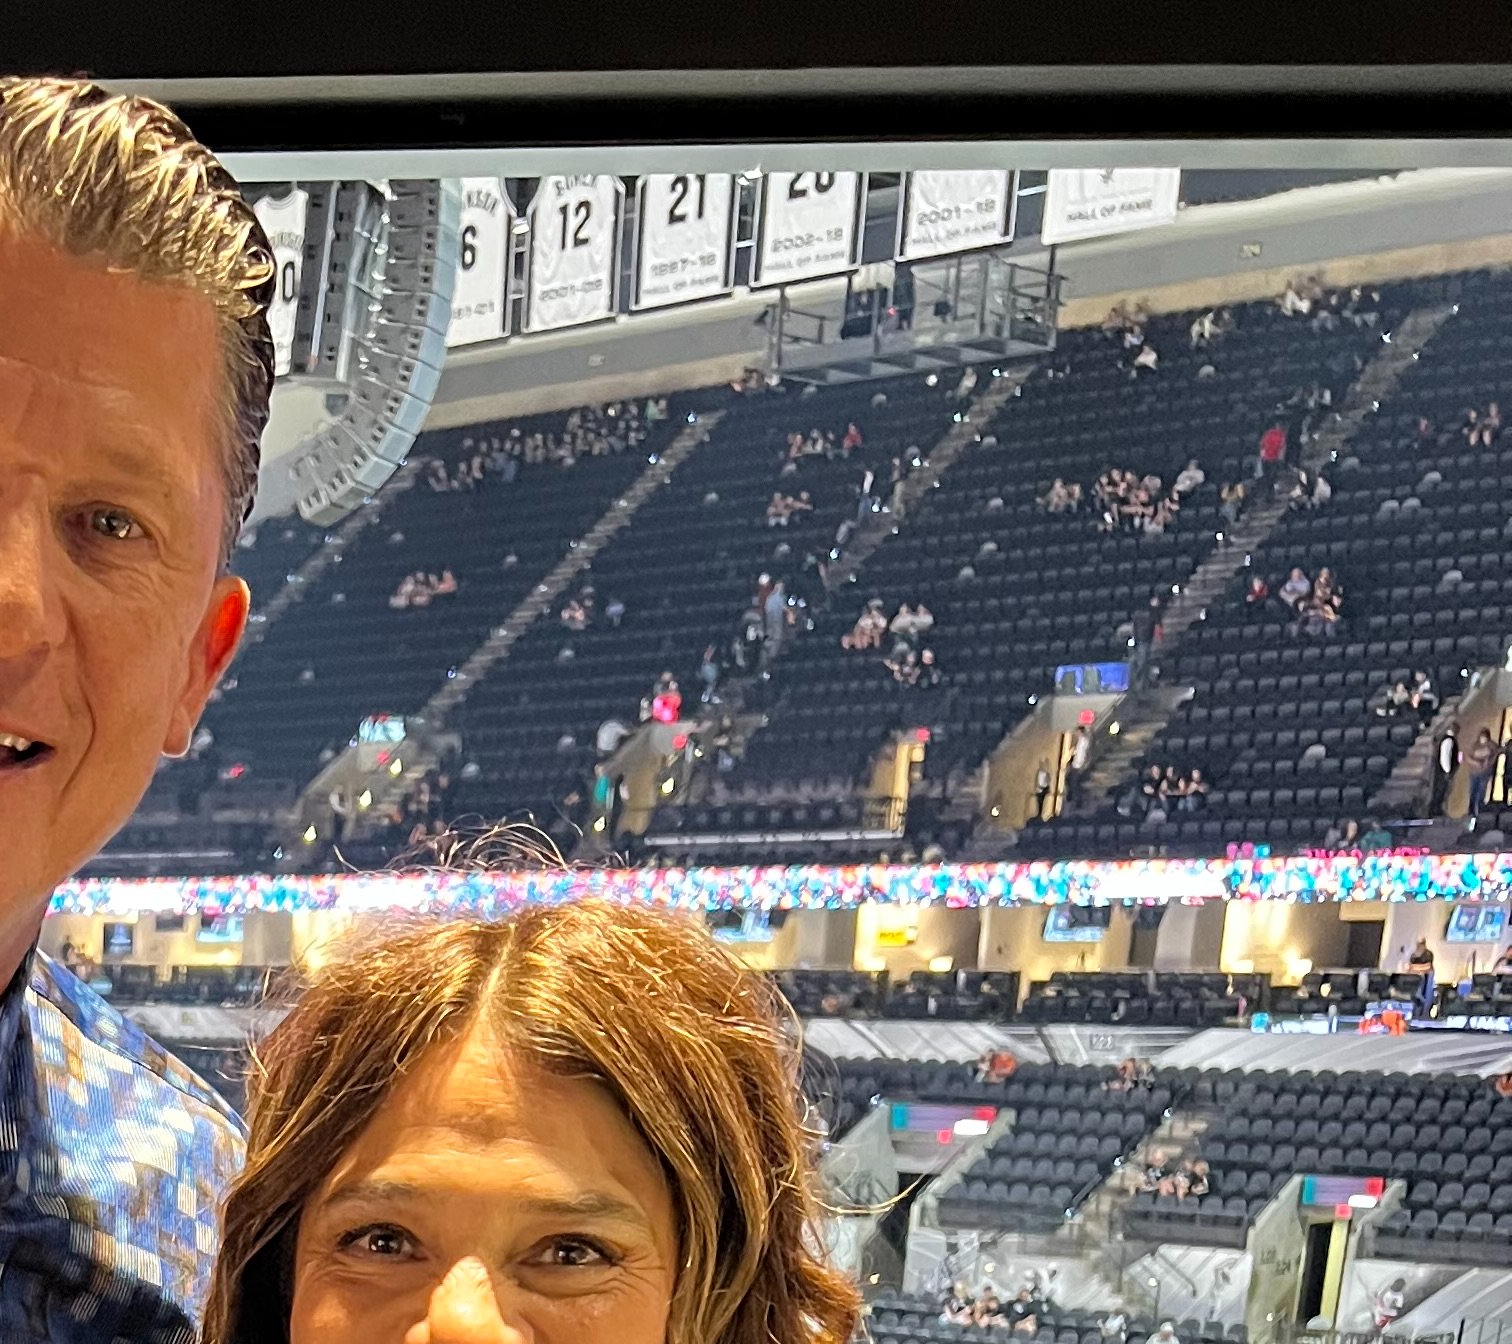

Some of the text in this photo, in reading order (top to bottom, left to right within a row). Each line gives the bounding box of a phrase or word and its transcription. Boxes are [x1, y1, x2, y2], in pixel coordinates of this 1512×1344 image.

[668, 174, 705, 225] 21
[462, 225, 477, 271] 6
[559, 200, 591, 251] 12
